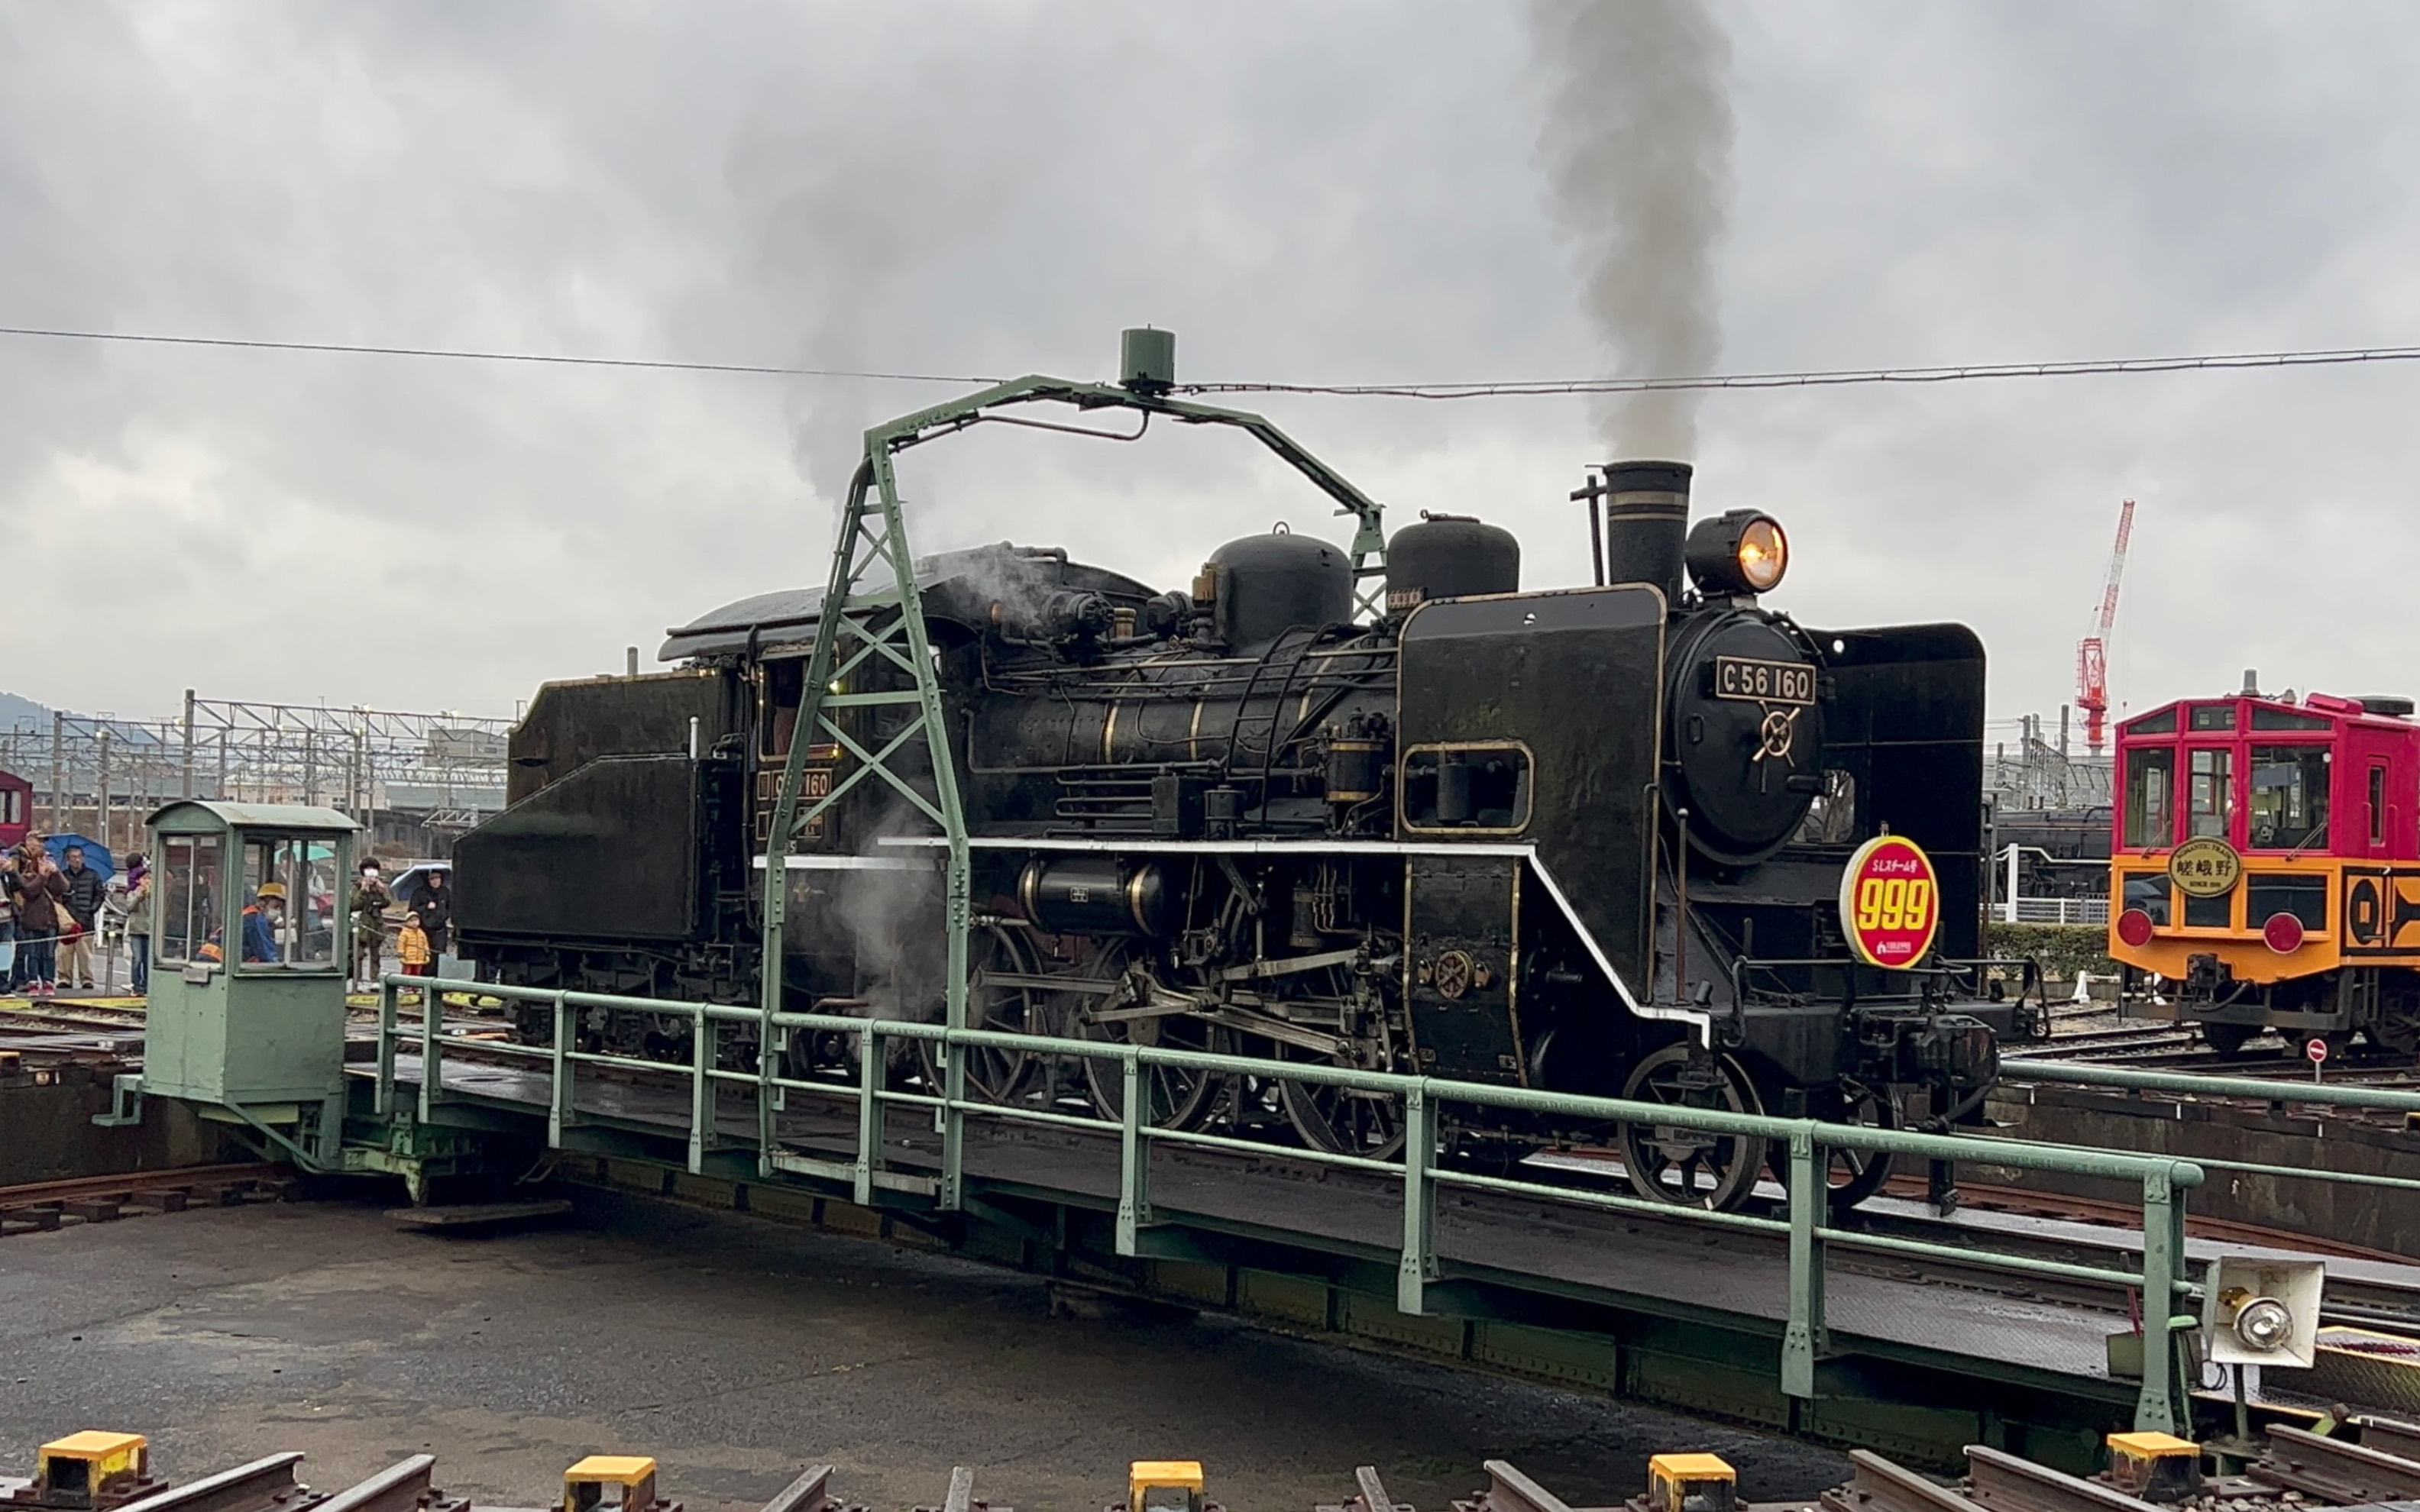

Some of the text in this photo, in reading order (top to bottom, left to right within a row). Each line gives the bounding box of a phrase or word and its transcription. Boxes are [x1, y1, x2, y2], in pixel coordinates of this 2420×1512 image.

[1775, 668, 1809, 699] 160
[805, 774, 827, 796] 160
[2176, 860, 2232, 877] 嵯峨野
[1858, 878, 1930, 930] 999
